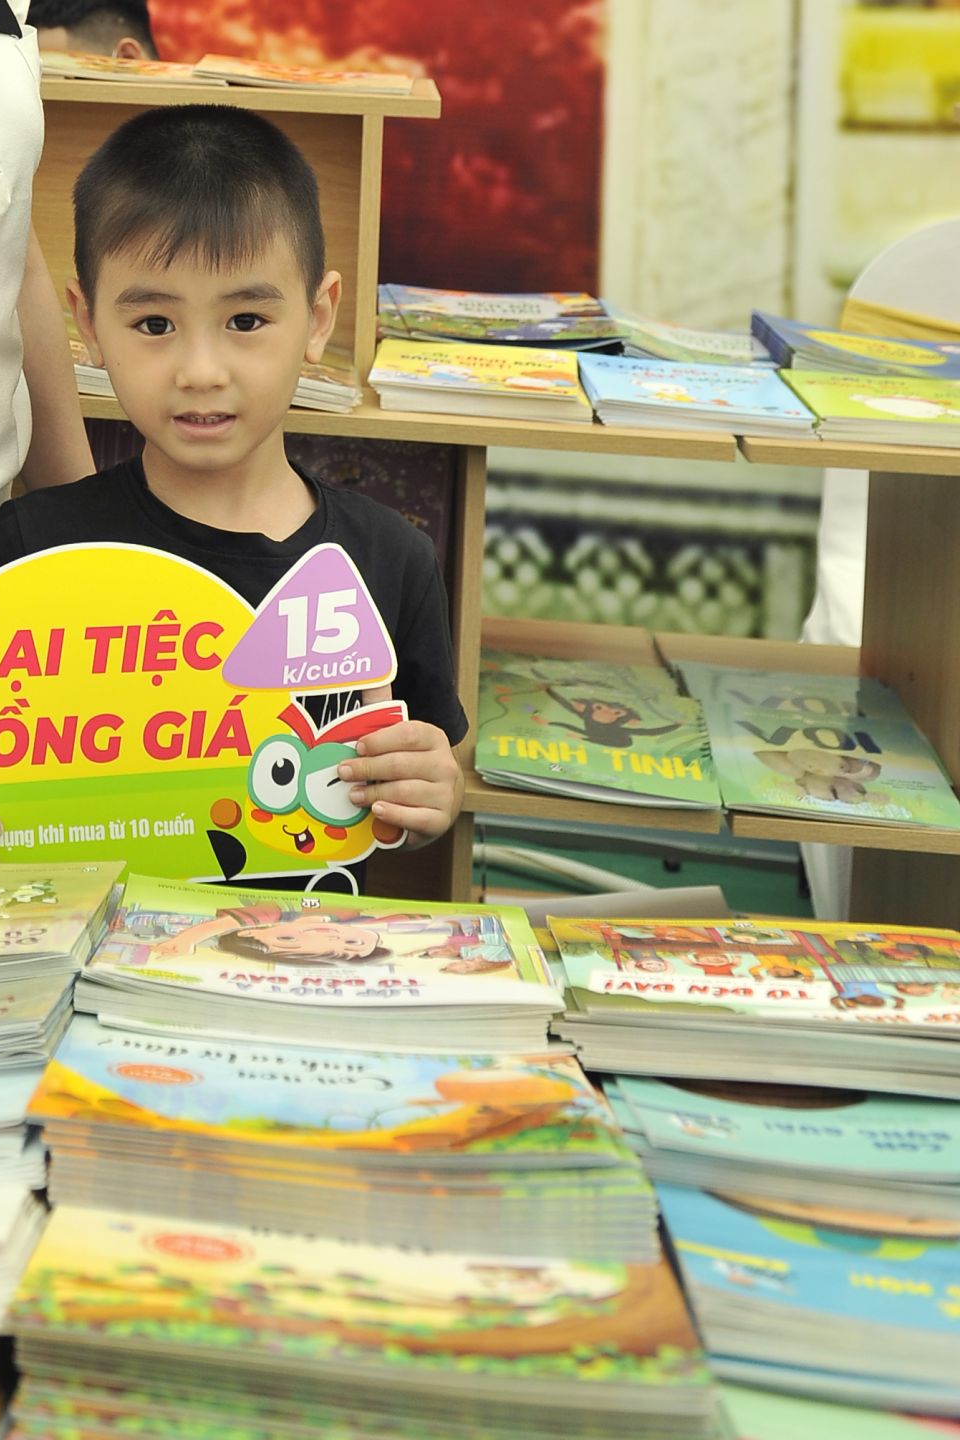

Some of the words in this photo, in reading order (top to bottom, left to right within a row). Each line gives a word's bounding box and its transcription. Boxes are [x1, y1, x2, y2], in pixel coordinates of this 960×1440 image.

[278, 588, 360, 659] 15
[84, 610, 224, 686] TIỆC
[282, 651, 371, 685] k/cuốn
[143, 694, 253, 760] GIÁ
[734, 720, 883, 754] VOI
[490, 734, 588, 765] TINH
[604, 748, 703, 781] TINH
[38, 823, 65, 845] khi
[68, 822, 105, 843] mua
[108, 819, 126, 840] từ
[130, 818, 150, 838] 10
[153, 812, 195, 836] cuốn
[603, 979, 675, 993] ĐÂY!
[687, 984, 755, 999] ĐẾN
